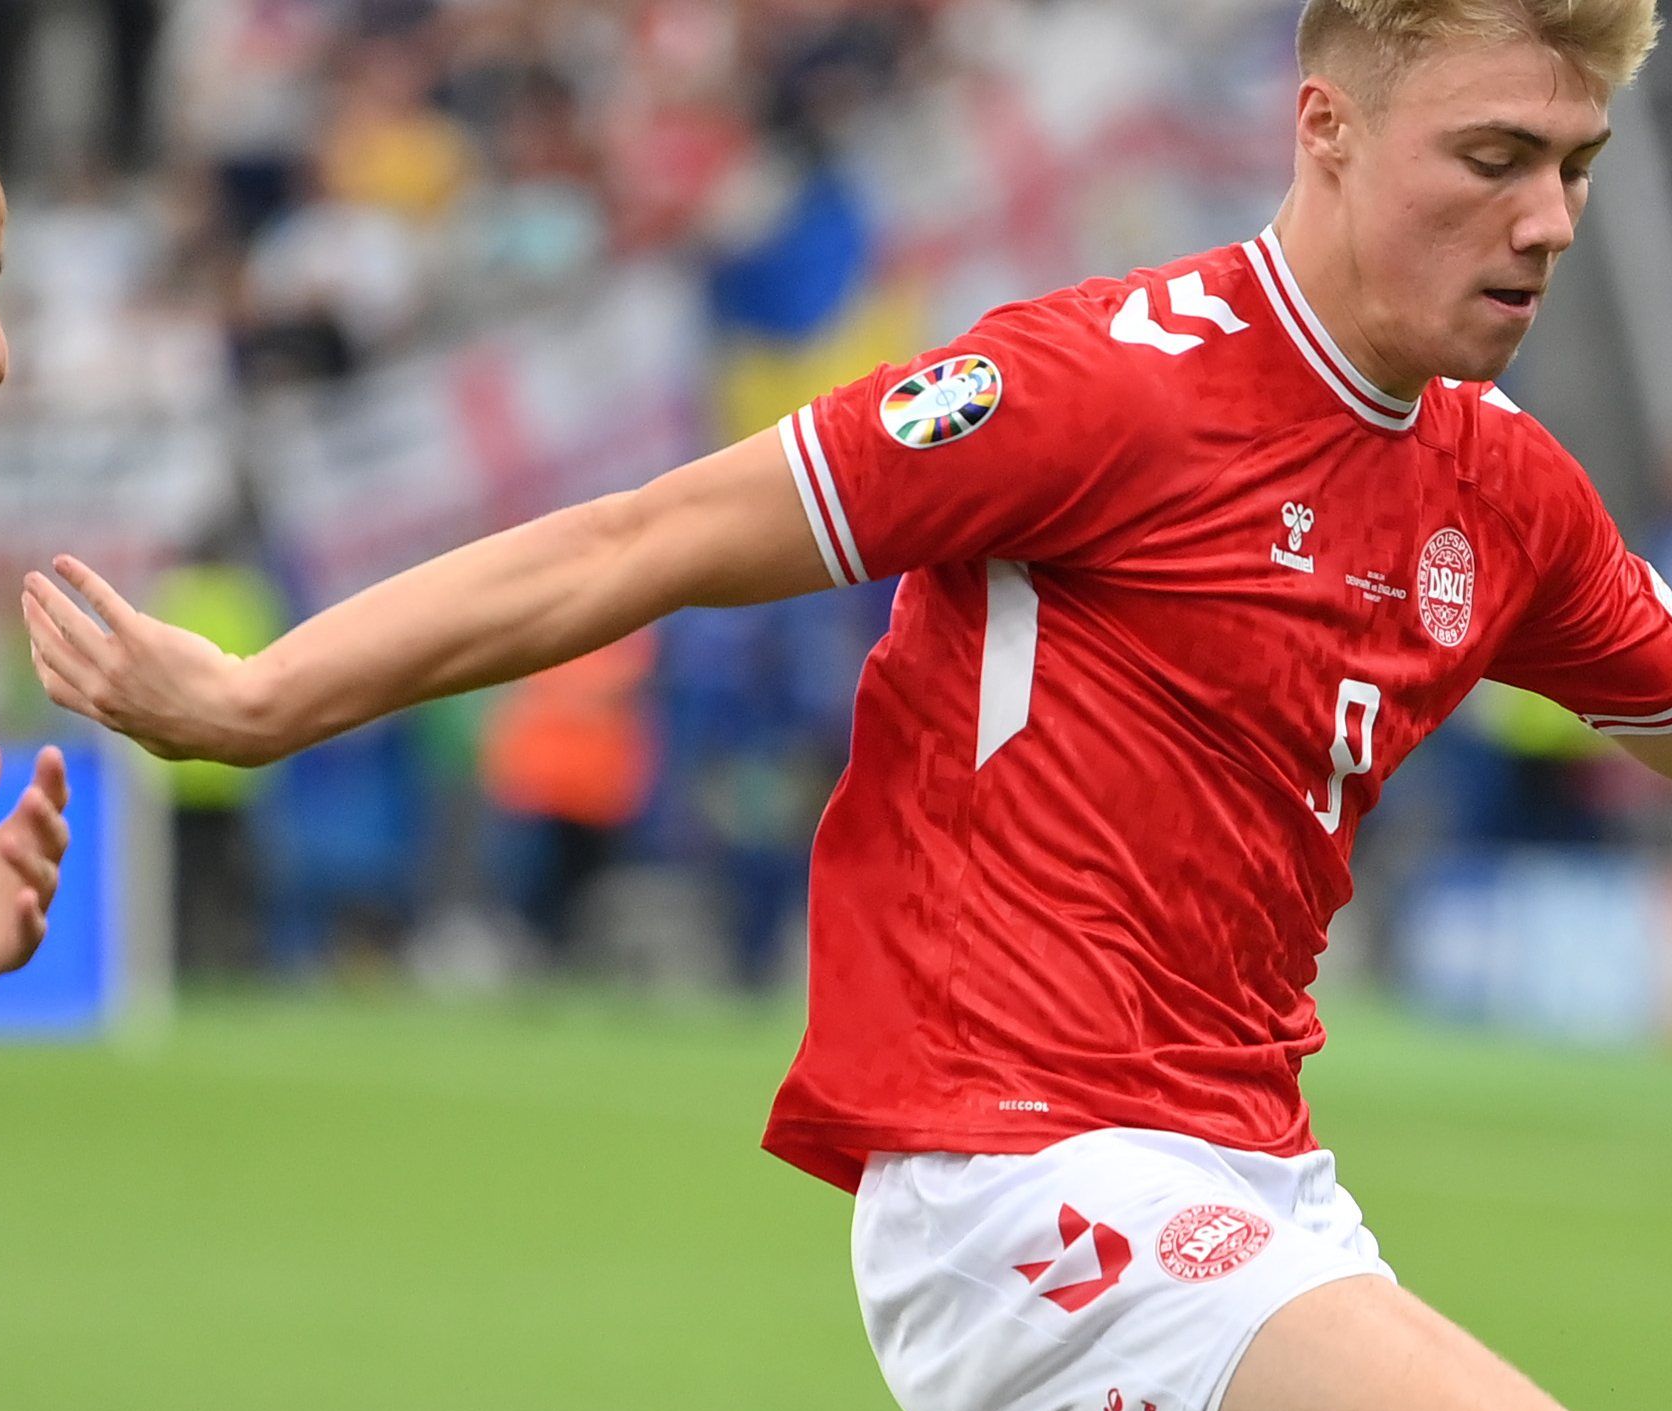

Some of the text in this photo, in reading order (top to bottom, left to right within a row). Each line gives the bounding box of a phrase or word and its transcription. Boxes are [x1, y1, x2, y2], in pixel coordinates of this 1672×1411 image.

[1271, 543, 1314, 574] hummel
[1428, 566, 1466, 605] DBU
[1433, 625, 1458, 643] 1889
[999, 1100, 1049, 1112] BEECOOL
[1180, 1215, 1247, 1263] DBU
